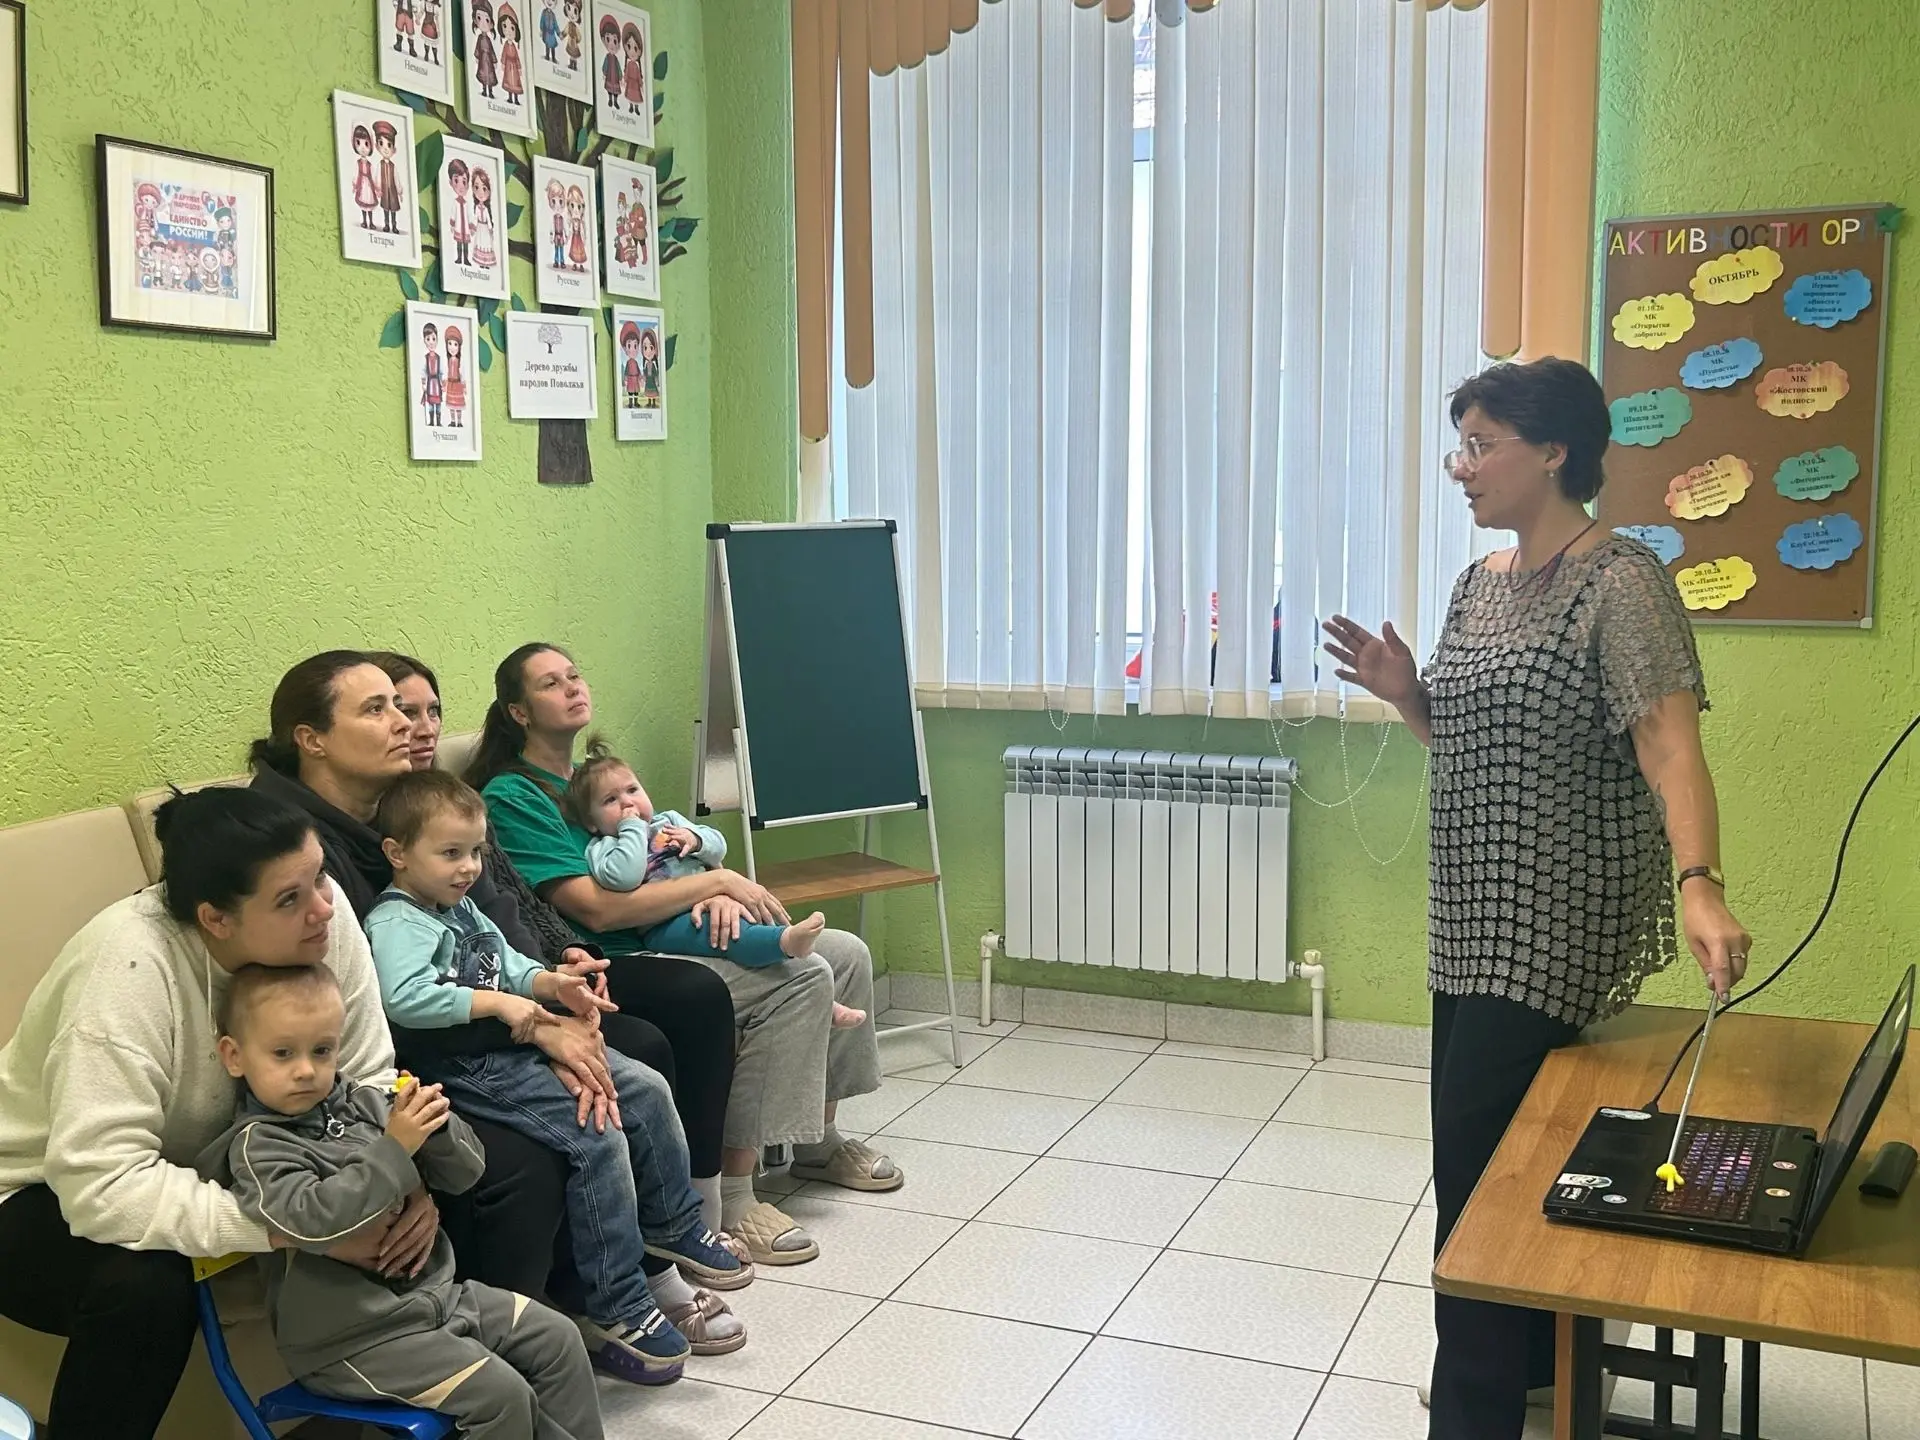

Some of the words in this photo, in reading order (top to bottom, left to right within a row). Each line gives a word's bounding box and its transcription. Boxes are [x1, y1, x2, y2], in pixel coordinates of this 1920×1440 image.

[170, 213, 208, 228] ЕДИНСТВО
[169, 226, 208, 240] РОССИИ!
[368, 232, 395, 248] Татары
[1609, 222, 1808, 256] АКТИВНОСТИ
[557, 274, 580, 287] Русские
[1708, 268, 1760, 285] ОКТЯБРЬ
[1644, 313, 1657, 321] МК
[525, 361, 550, 373] Дерево
[551, 363, 578, 375] дружбы
[519, 379, 549, 390] народов
[550, 378, 584, 389] Поволжья
